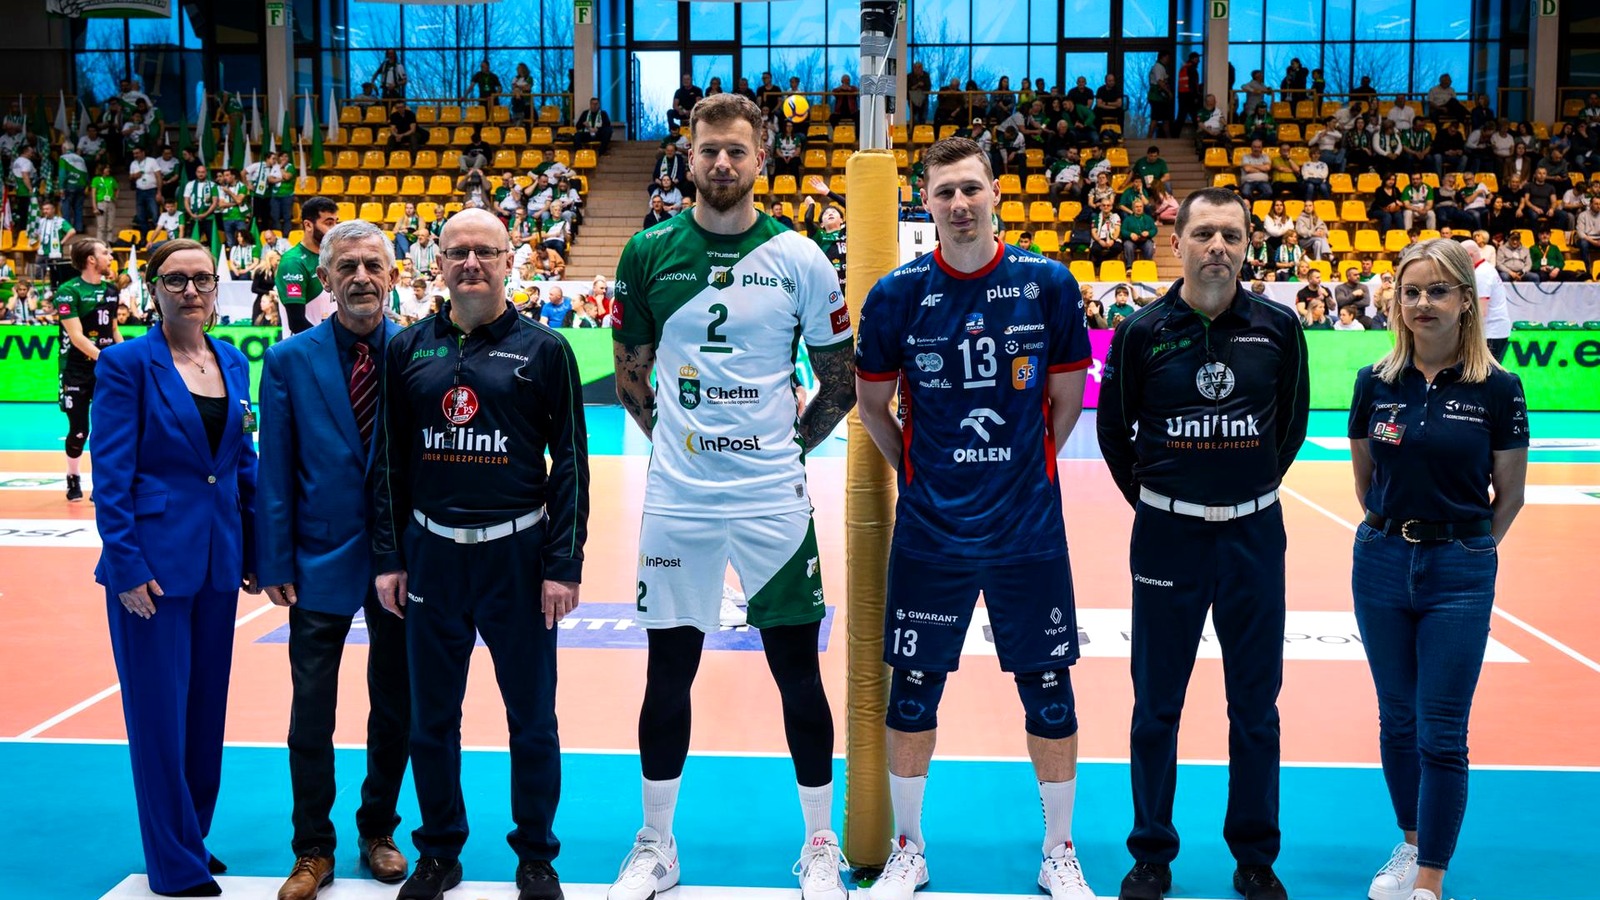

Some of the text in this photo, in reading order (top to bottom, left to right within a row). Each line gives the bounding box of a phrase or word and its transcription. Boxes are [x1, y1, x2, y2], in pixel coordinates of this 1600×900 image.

[578, 7, 589, 23] F
[1213, 2, 1227, 18] D
[1543, 0, 1556, 15] D
[271, 9, 281, 25] F
[714, 251, 740, 259] hummel
[1018, 256, 1047, 264] EMKA
[655, 272, 697, 281] LUXIONA
[742, 272, 778, 288] plus
[920, 293, 944, 307] 4F
[986, 284, 1021, 303] plus
[97, 309, 109, 326] 16
[707, 303, 728, 343] 2
[1004, 323, 1045, 335] Solidaris
[412, 347, 435, 361] plus
[1152, 341, 1177, 356] plus
[957, 336, 998, 380] 13
[1017, 364, 1035, 381] STS
[706, 386, 759, 399] Chełm
[1166, 414, 1260, 438] Unilink
[422, 426, 509, 453] Unilink
[699, 435, 761, 453] InPost
[1166, 440, 1193, 449] LIDER
[443, 453, 509, 465] UBEZPIECZEŃ
[953, 447, 1012, 463] ORLEN
[645, 555, 682, 568] InPost
[1139, 576, 1174, 587] DECATHLON
[636, 580, 648, 613] 2
[908, 610, 959, 623] GWARANT
[893, 627, 918, 657] 13
[1050, 641, 1069, 657] 4F
